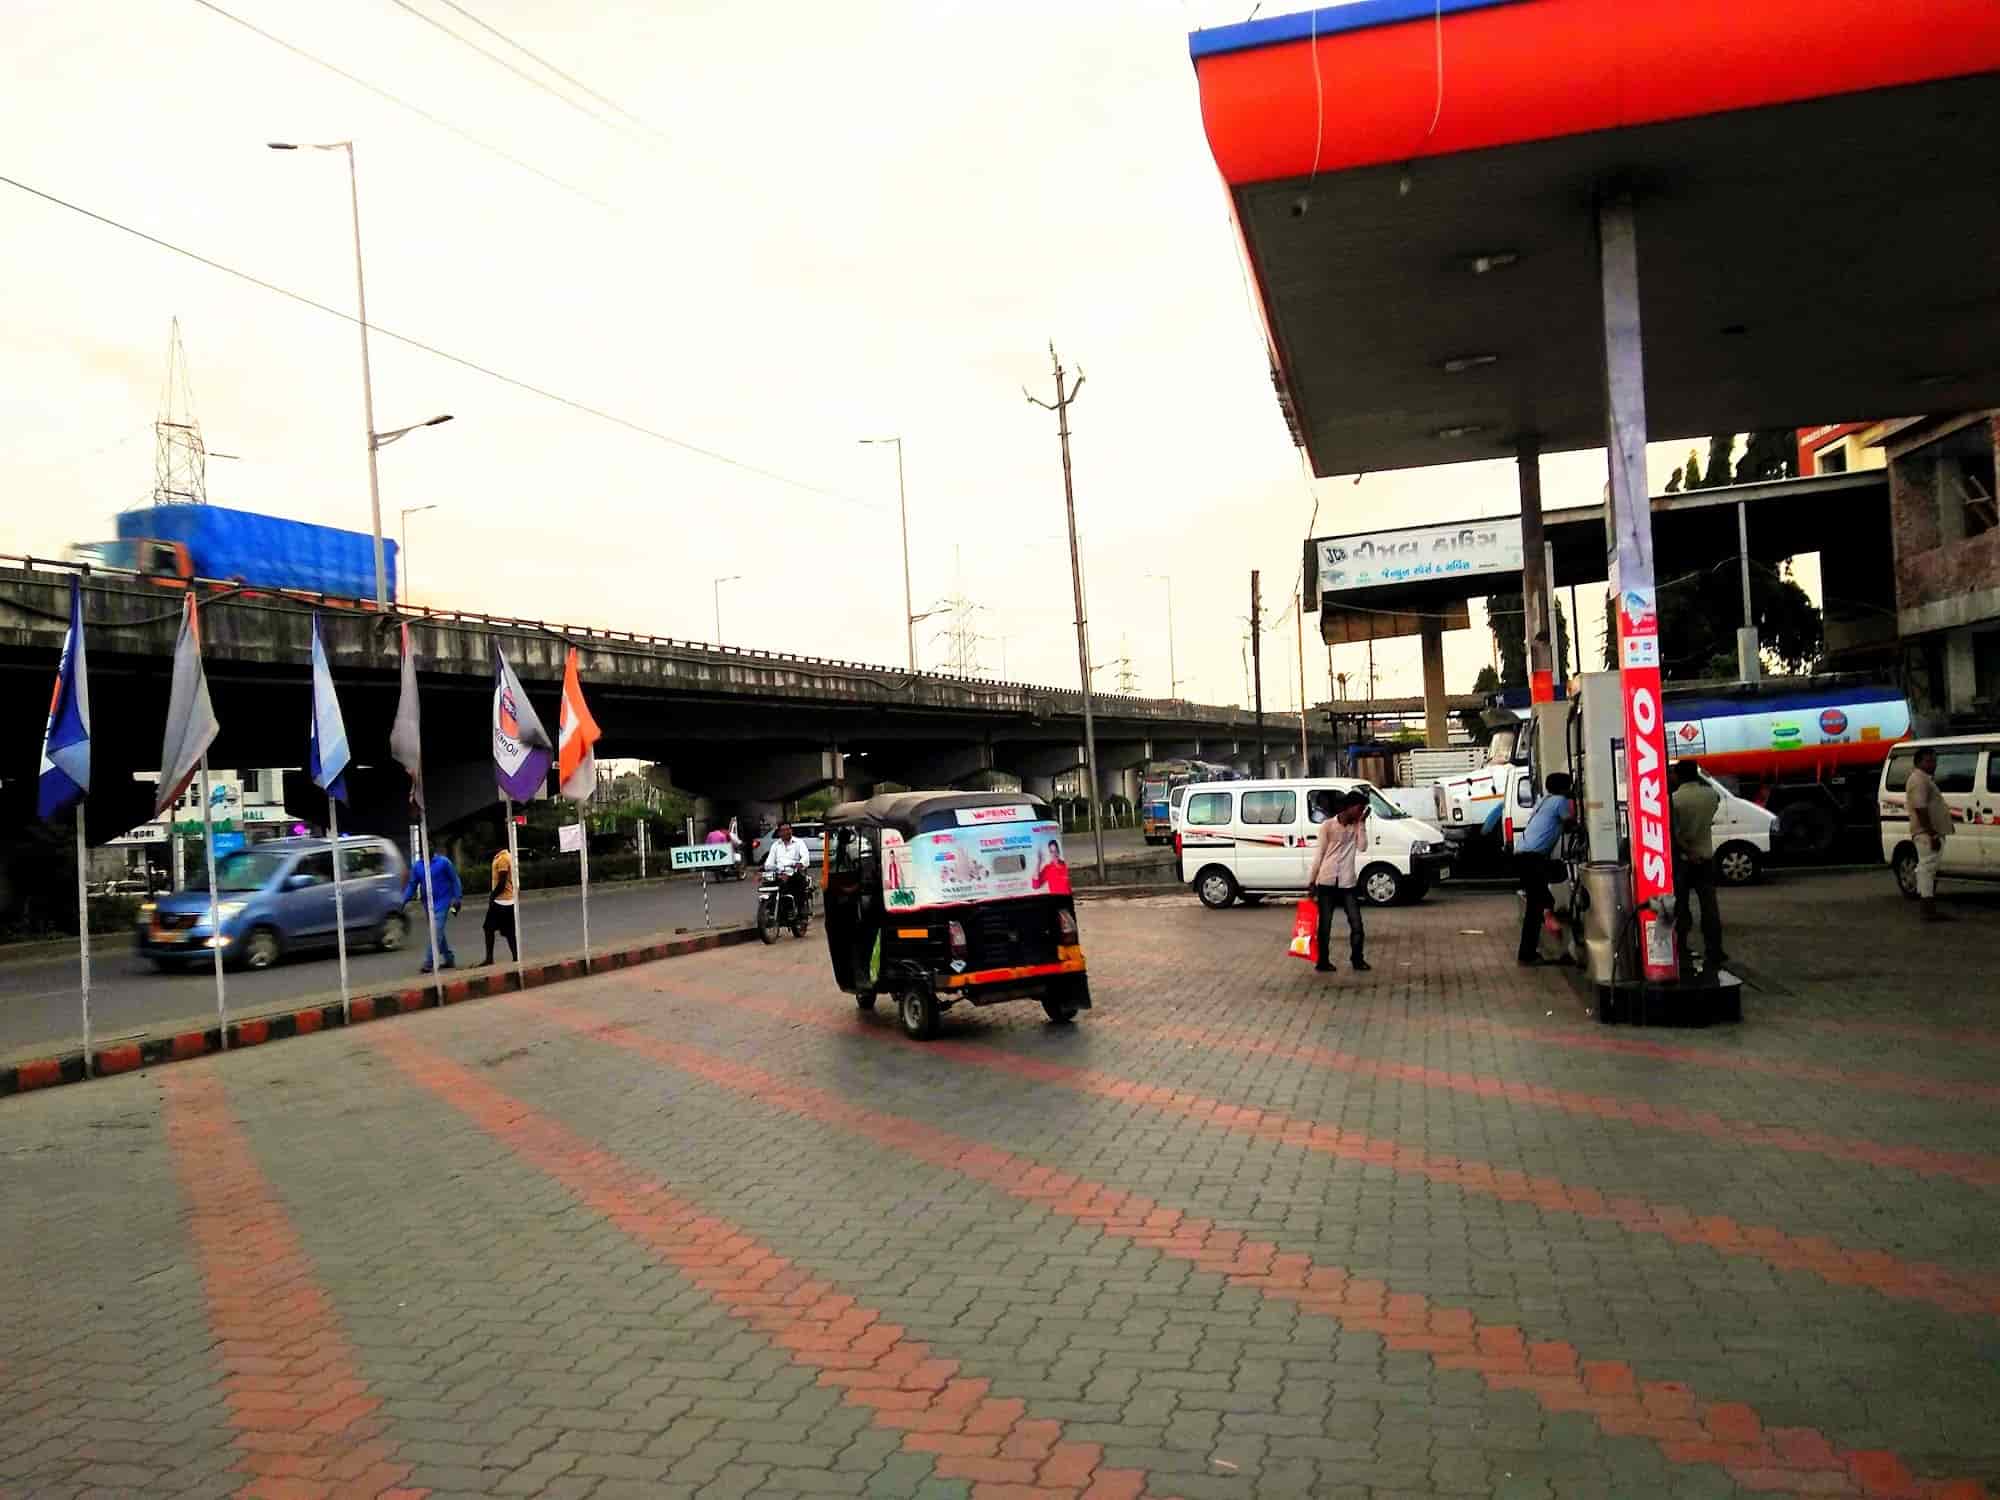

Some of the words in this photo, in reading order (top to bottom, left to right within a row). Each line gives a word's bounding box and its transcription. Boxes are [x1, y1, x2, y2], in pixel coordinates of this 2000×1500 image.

[1326, 548, 1347, 564] JCB
[1633, 687, 1665, 889] SERVO
[984, 808, 1016, 818] PRINCE
[675, 849, 718, 864] ENTRY
